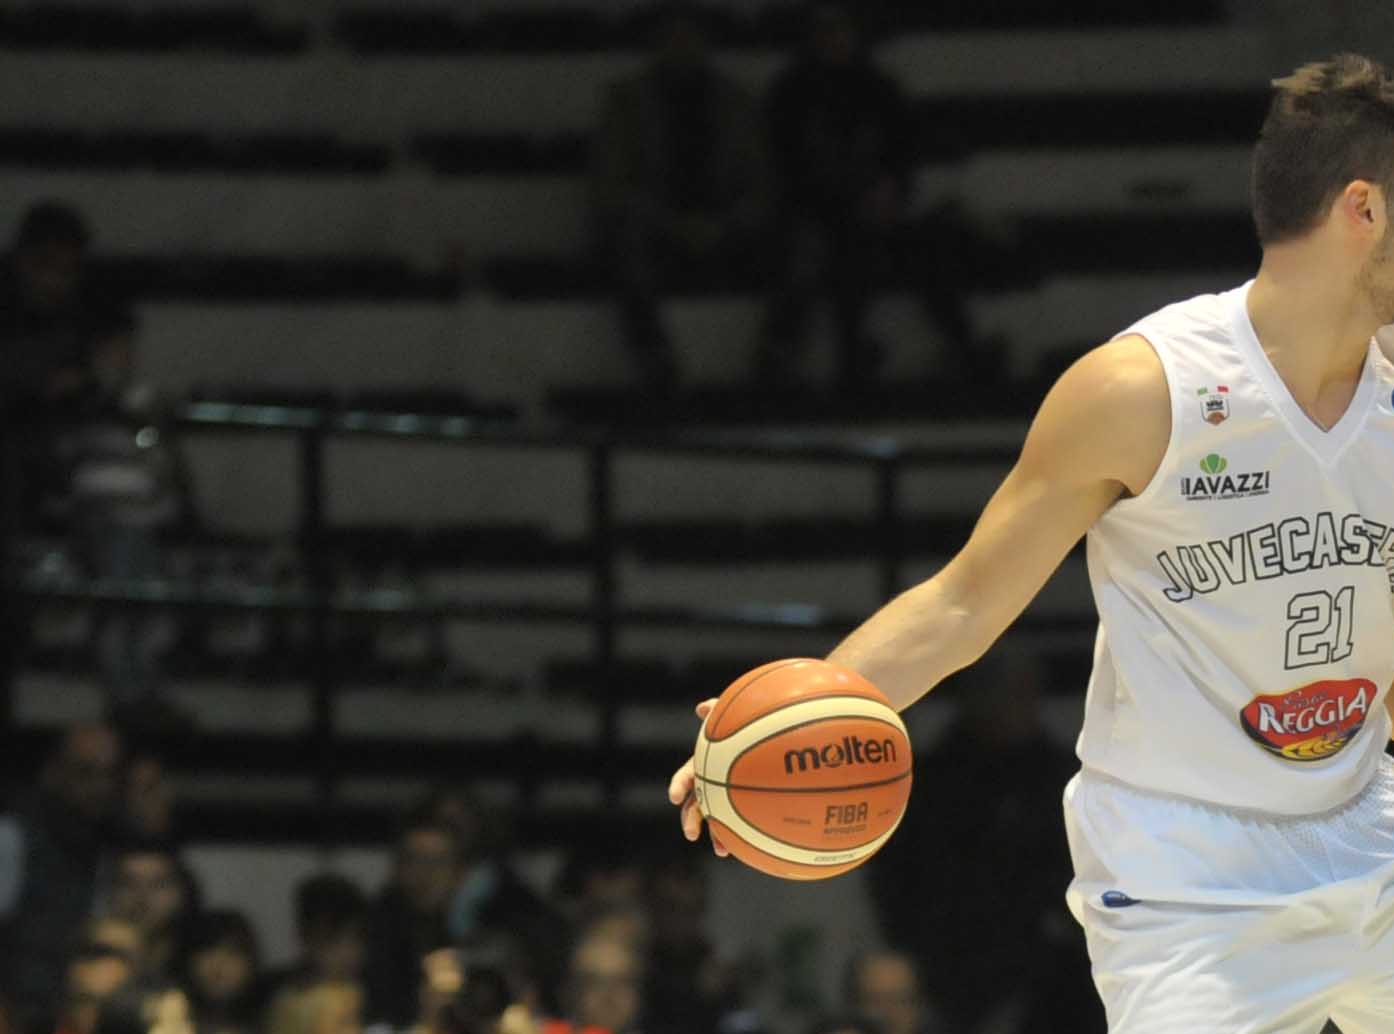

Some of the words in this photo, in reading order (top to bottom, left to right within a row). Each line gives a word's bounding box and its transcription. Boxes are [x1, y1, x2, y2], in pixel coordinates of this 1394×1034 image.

[1284, 586, 1355, 670] 21
[1258, 687, 1368, 734] REGGIA
[784, 736, 897, 775] molten
[824, 801, 869, 824] FIBA
